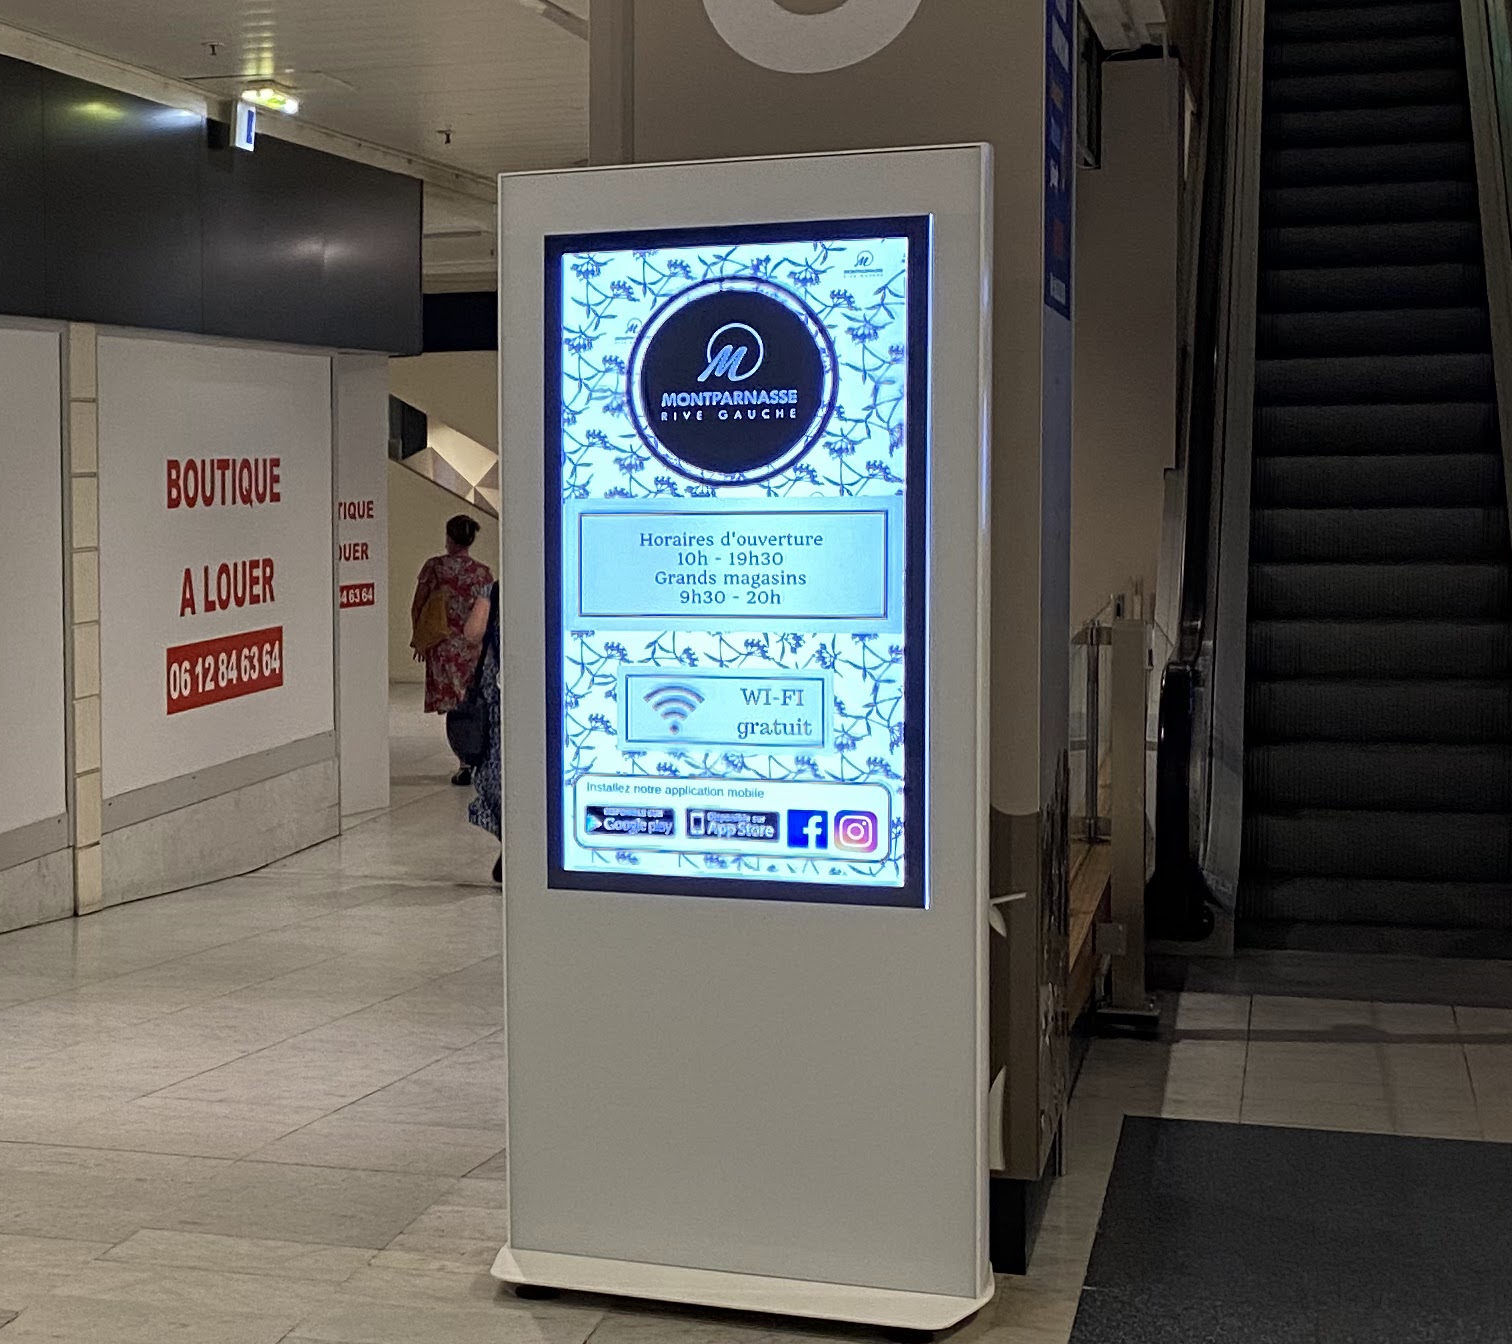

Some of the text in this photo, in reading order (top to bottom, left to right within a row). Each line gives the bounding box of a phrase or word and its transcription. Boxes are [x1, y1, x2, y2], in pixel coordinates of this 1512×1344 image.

[661, 389, 798, 408] MONTPARNASSE
[661, 408, 797, 421] RIVE GAUCHE
[167, 458, 281, 509] BOUTIQUE
[640, 531, 823, 547] Horaires d'ouverture
[678, 552, 708, 566] 10h
[729, 552, 784, 566] 19h30
[180, 558, 275, 617] A LOUER
[654, 570, 807, 589] Grands magasins
[348, 588, 360, 603] 63
[361, 587, 372, 602] 64
[679, 590, 726, 604] 9h30
[746, 590, 781, 605] 20h
[169, 640, 280, 699] 06 12 84 63 64
[740, 688, 804, 706] WI-FI
[737, 718, 812, 739] gratuit
[587, 782, 765, 798] Installez notre application mobile
[603, 817, 673, 835] Google play
[707, 822, 775, 838] App Store
